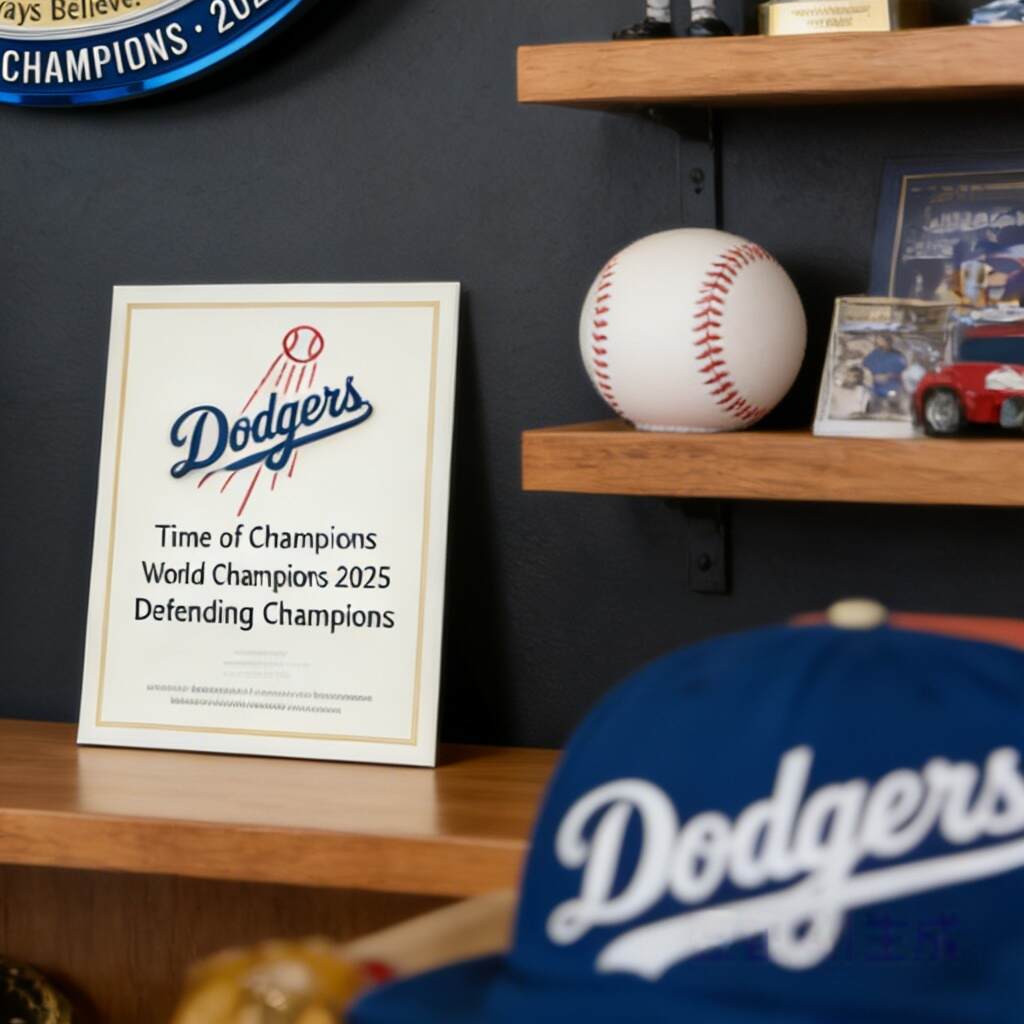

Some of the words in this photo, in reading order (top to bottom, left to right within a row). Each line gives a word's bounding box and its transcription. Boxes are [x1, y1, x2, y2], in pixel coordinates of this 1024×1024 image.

[1, 22, 188, 84] CHAMPIONS
[170, 376, 374, 479] Dodgers
[155, 524, 212, 548] Time
[219, 524, 245, 548] of
[249, 525, 378, 555] Champions
[142, 561, 205, 586] World
[212, 562, 328, 593] Champions
[335, 566, 391, 589] 2025
[134, 597, 254, 631] Defending
[263, 601, 395, 634] Champions
[547, 745, 1024, 980] Dodgers
